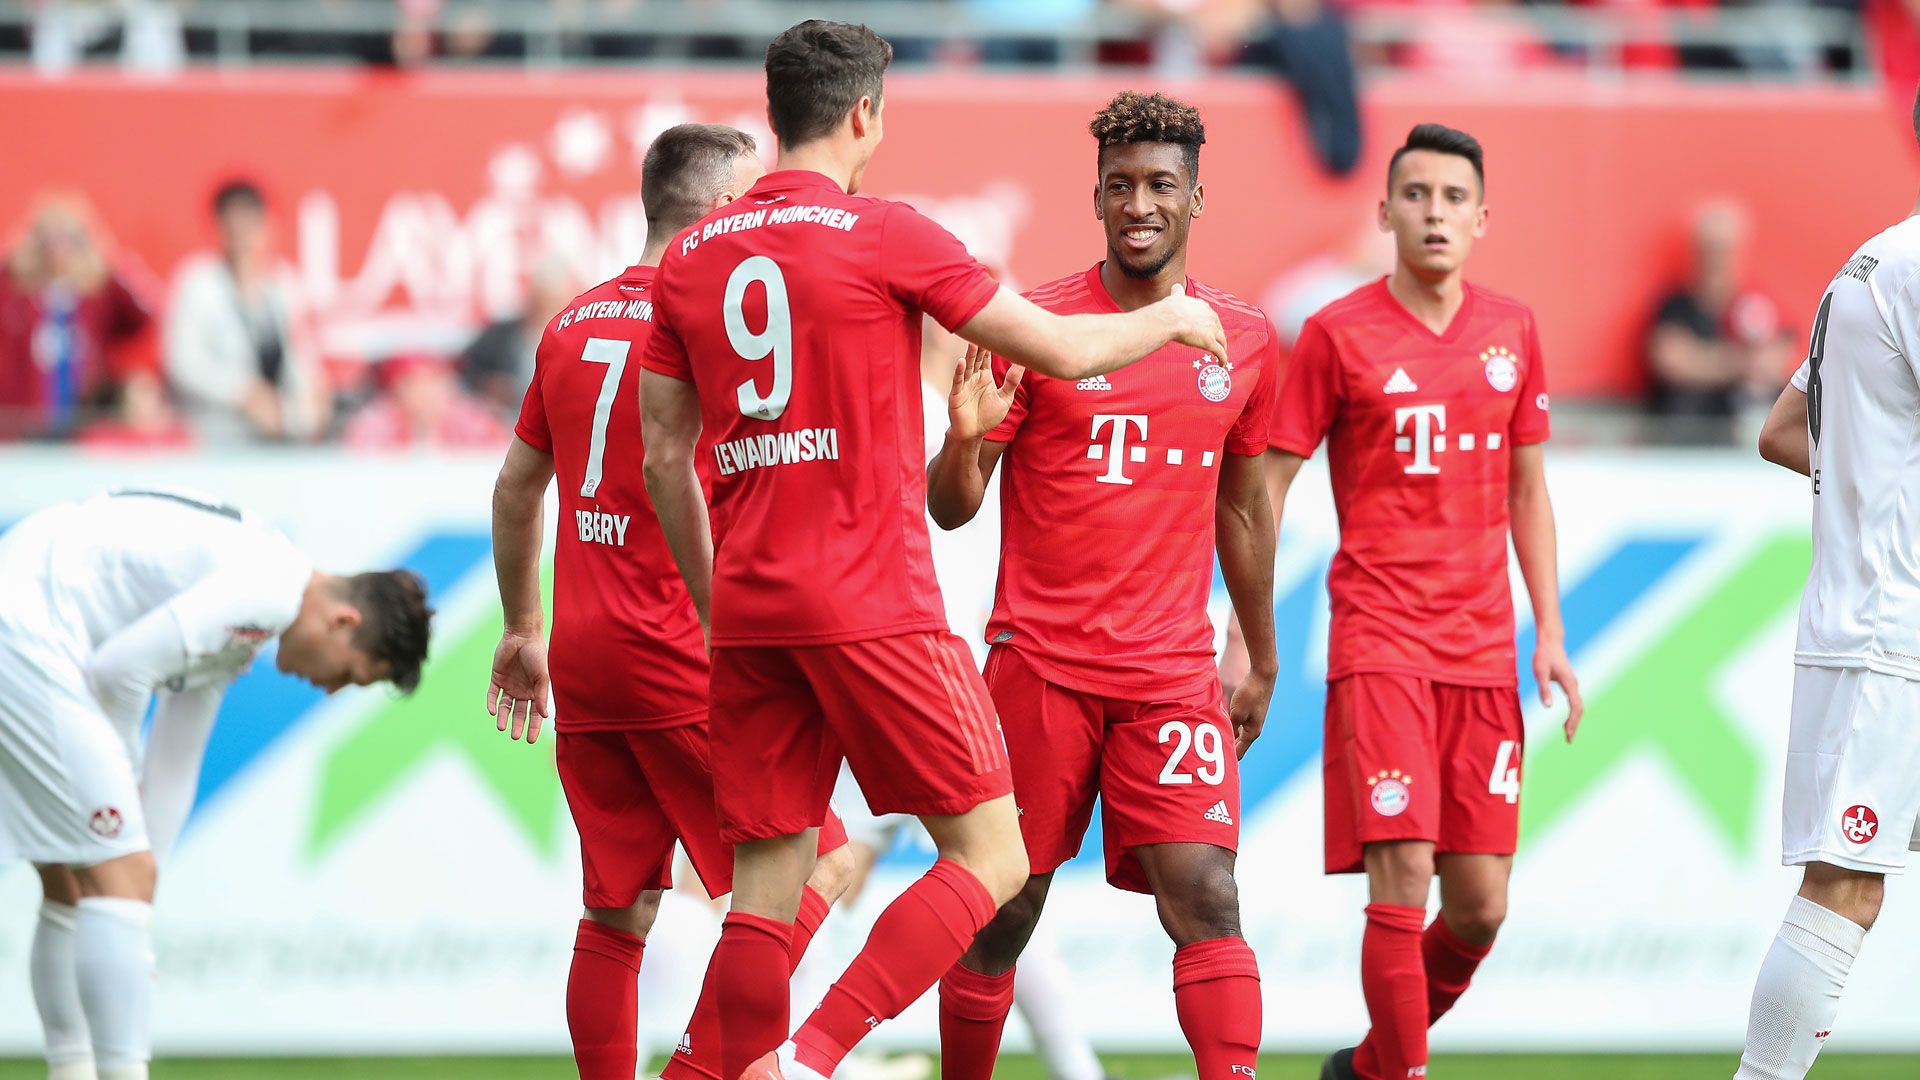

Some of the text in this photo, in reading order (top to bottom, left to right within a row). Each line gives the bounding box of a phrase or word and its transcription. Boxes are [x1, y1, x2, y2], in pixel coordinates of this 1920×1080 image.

[682, 230, 699, 257] FC
[702, 208, 767, 243] BAYERN
[557, 309, 575, 332] FC
[574, 300, 628, 324] BAYERN
[723, 255, 793, 421] 9
[1076, 382, 1112, 391] adidas
[580, 337, 632, 498] 7
[714, 428, 839, 476] LEWANDWSKI
[1158, 720, 1225, 786] 29
[1488, 740, 1522, 804] 4
[1203, 812, 1233, 826] adidas
